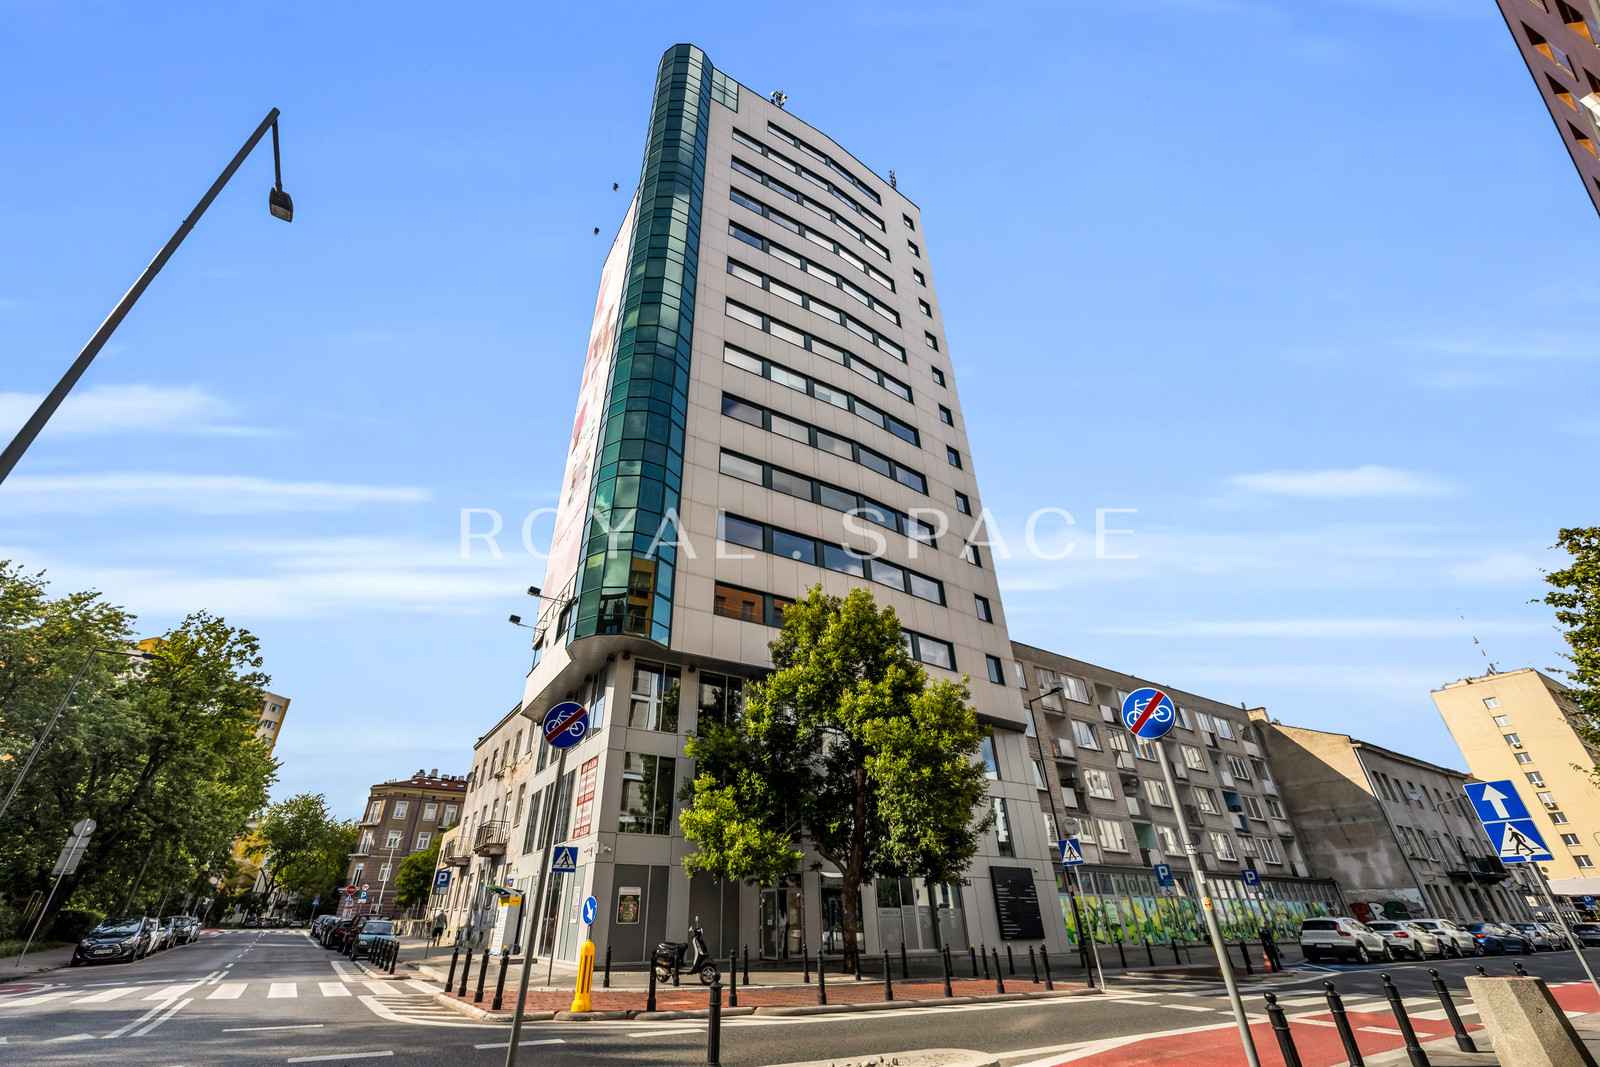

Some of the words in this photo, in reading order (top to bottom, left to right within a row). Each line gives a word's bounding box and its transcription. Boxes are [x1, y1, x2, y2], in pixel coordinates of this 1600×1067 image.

[437, 873, 448, 885] P
[1157, 865, 1169, 880] P
[1244, 871, 1256, 884] P
